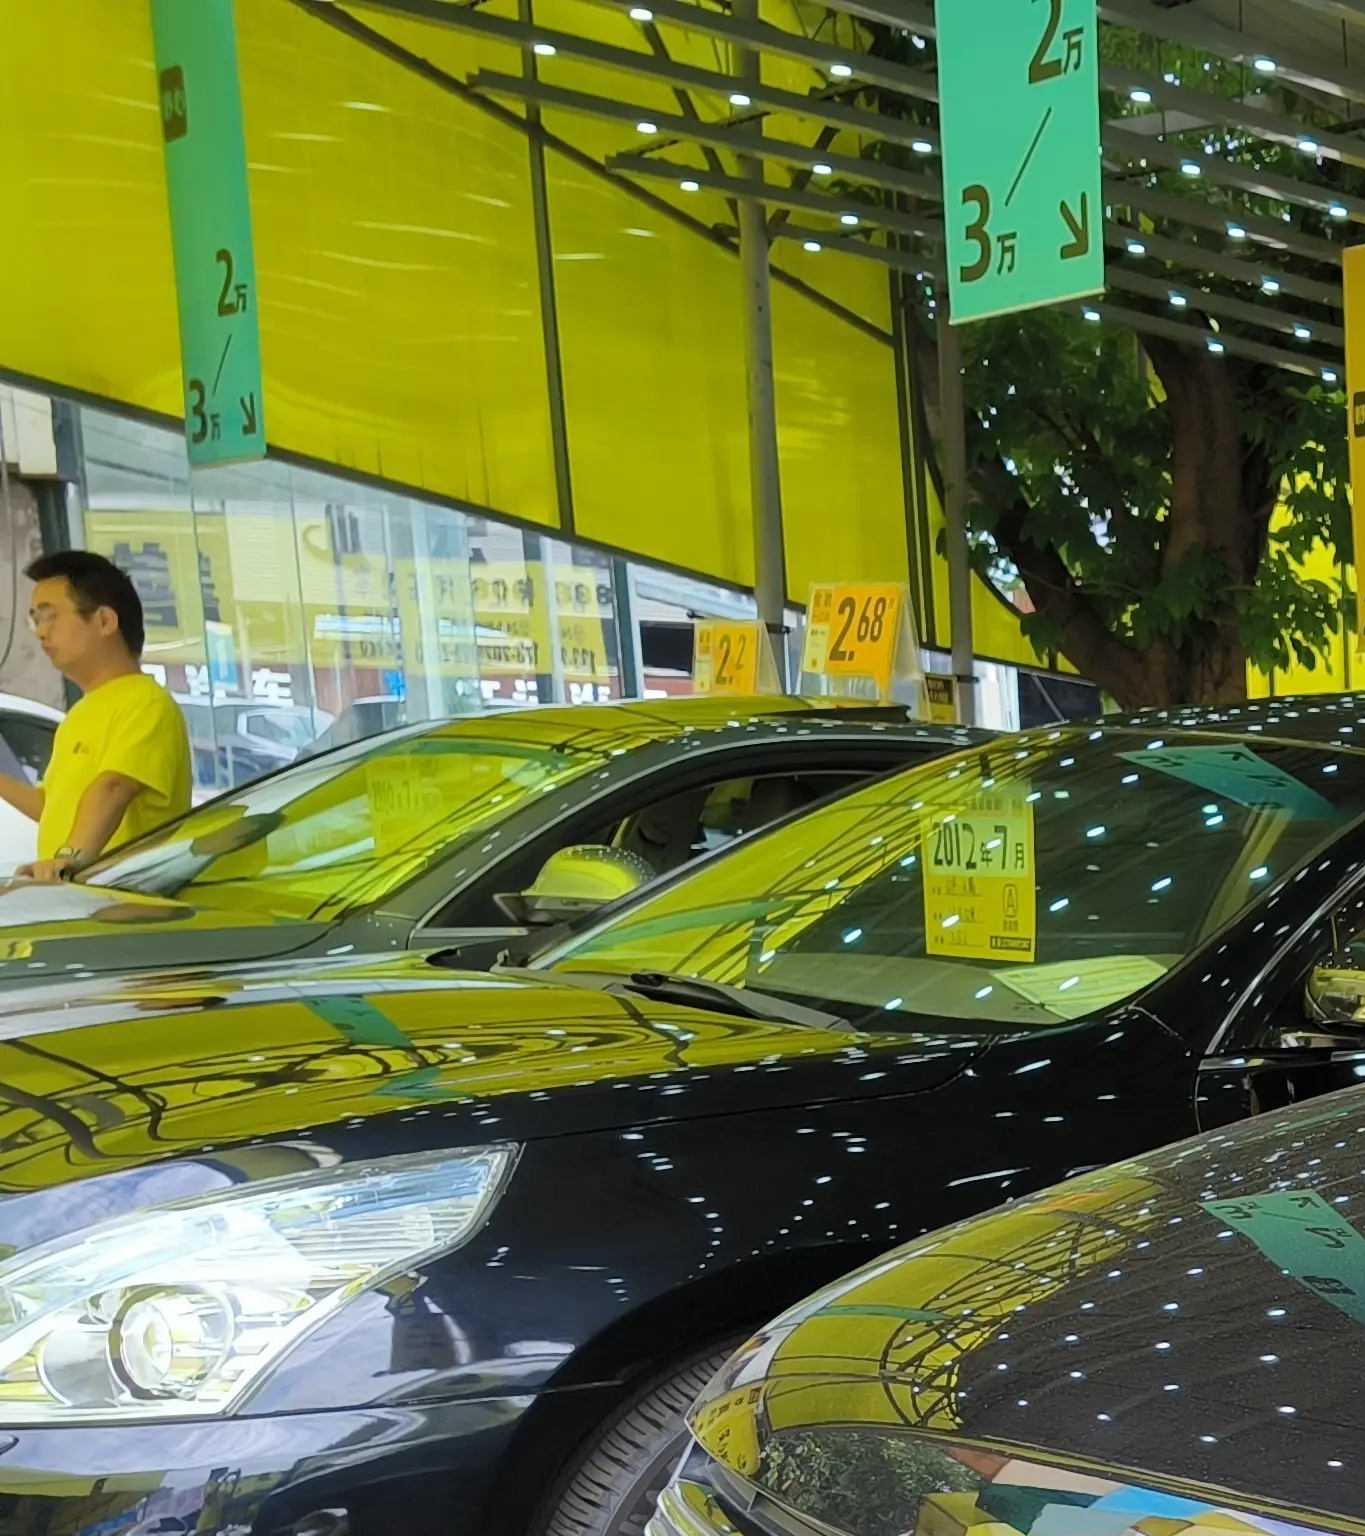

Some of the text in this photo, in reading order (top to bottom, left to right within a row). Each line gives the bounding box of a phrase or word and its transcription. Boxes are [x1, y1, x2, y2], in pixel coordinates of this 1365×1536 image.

[960, 184, 1017, 283] 3万
[216, 249, 247, 318] 2万
[189, 378, 221, 445] 3万
